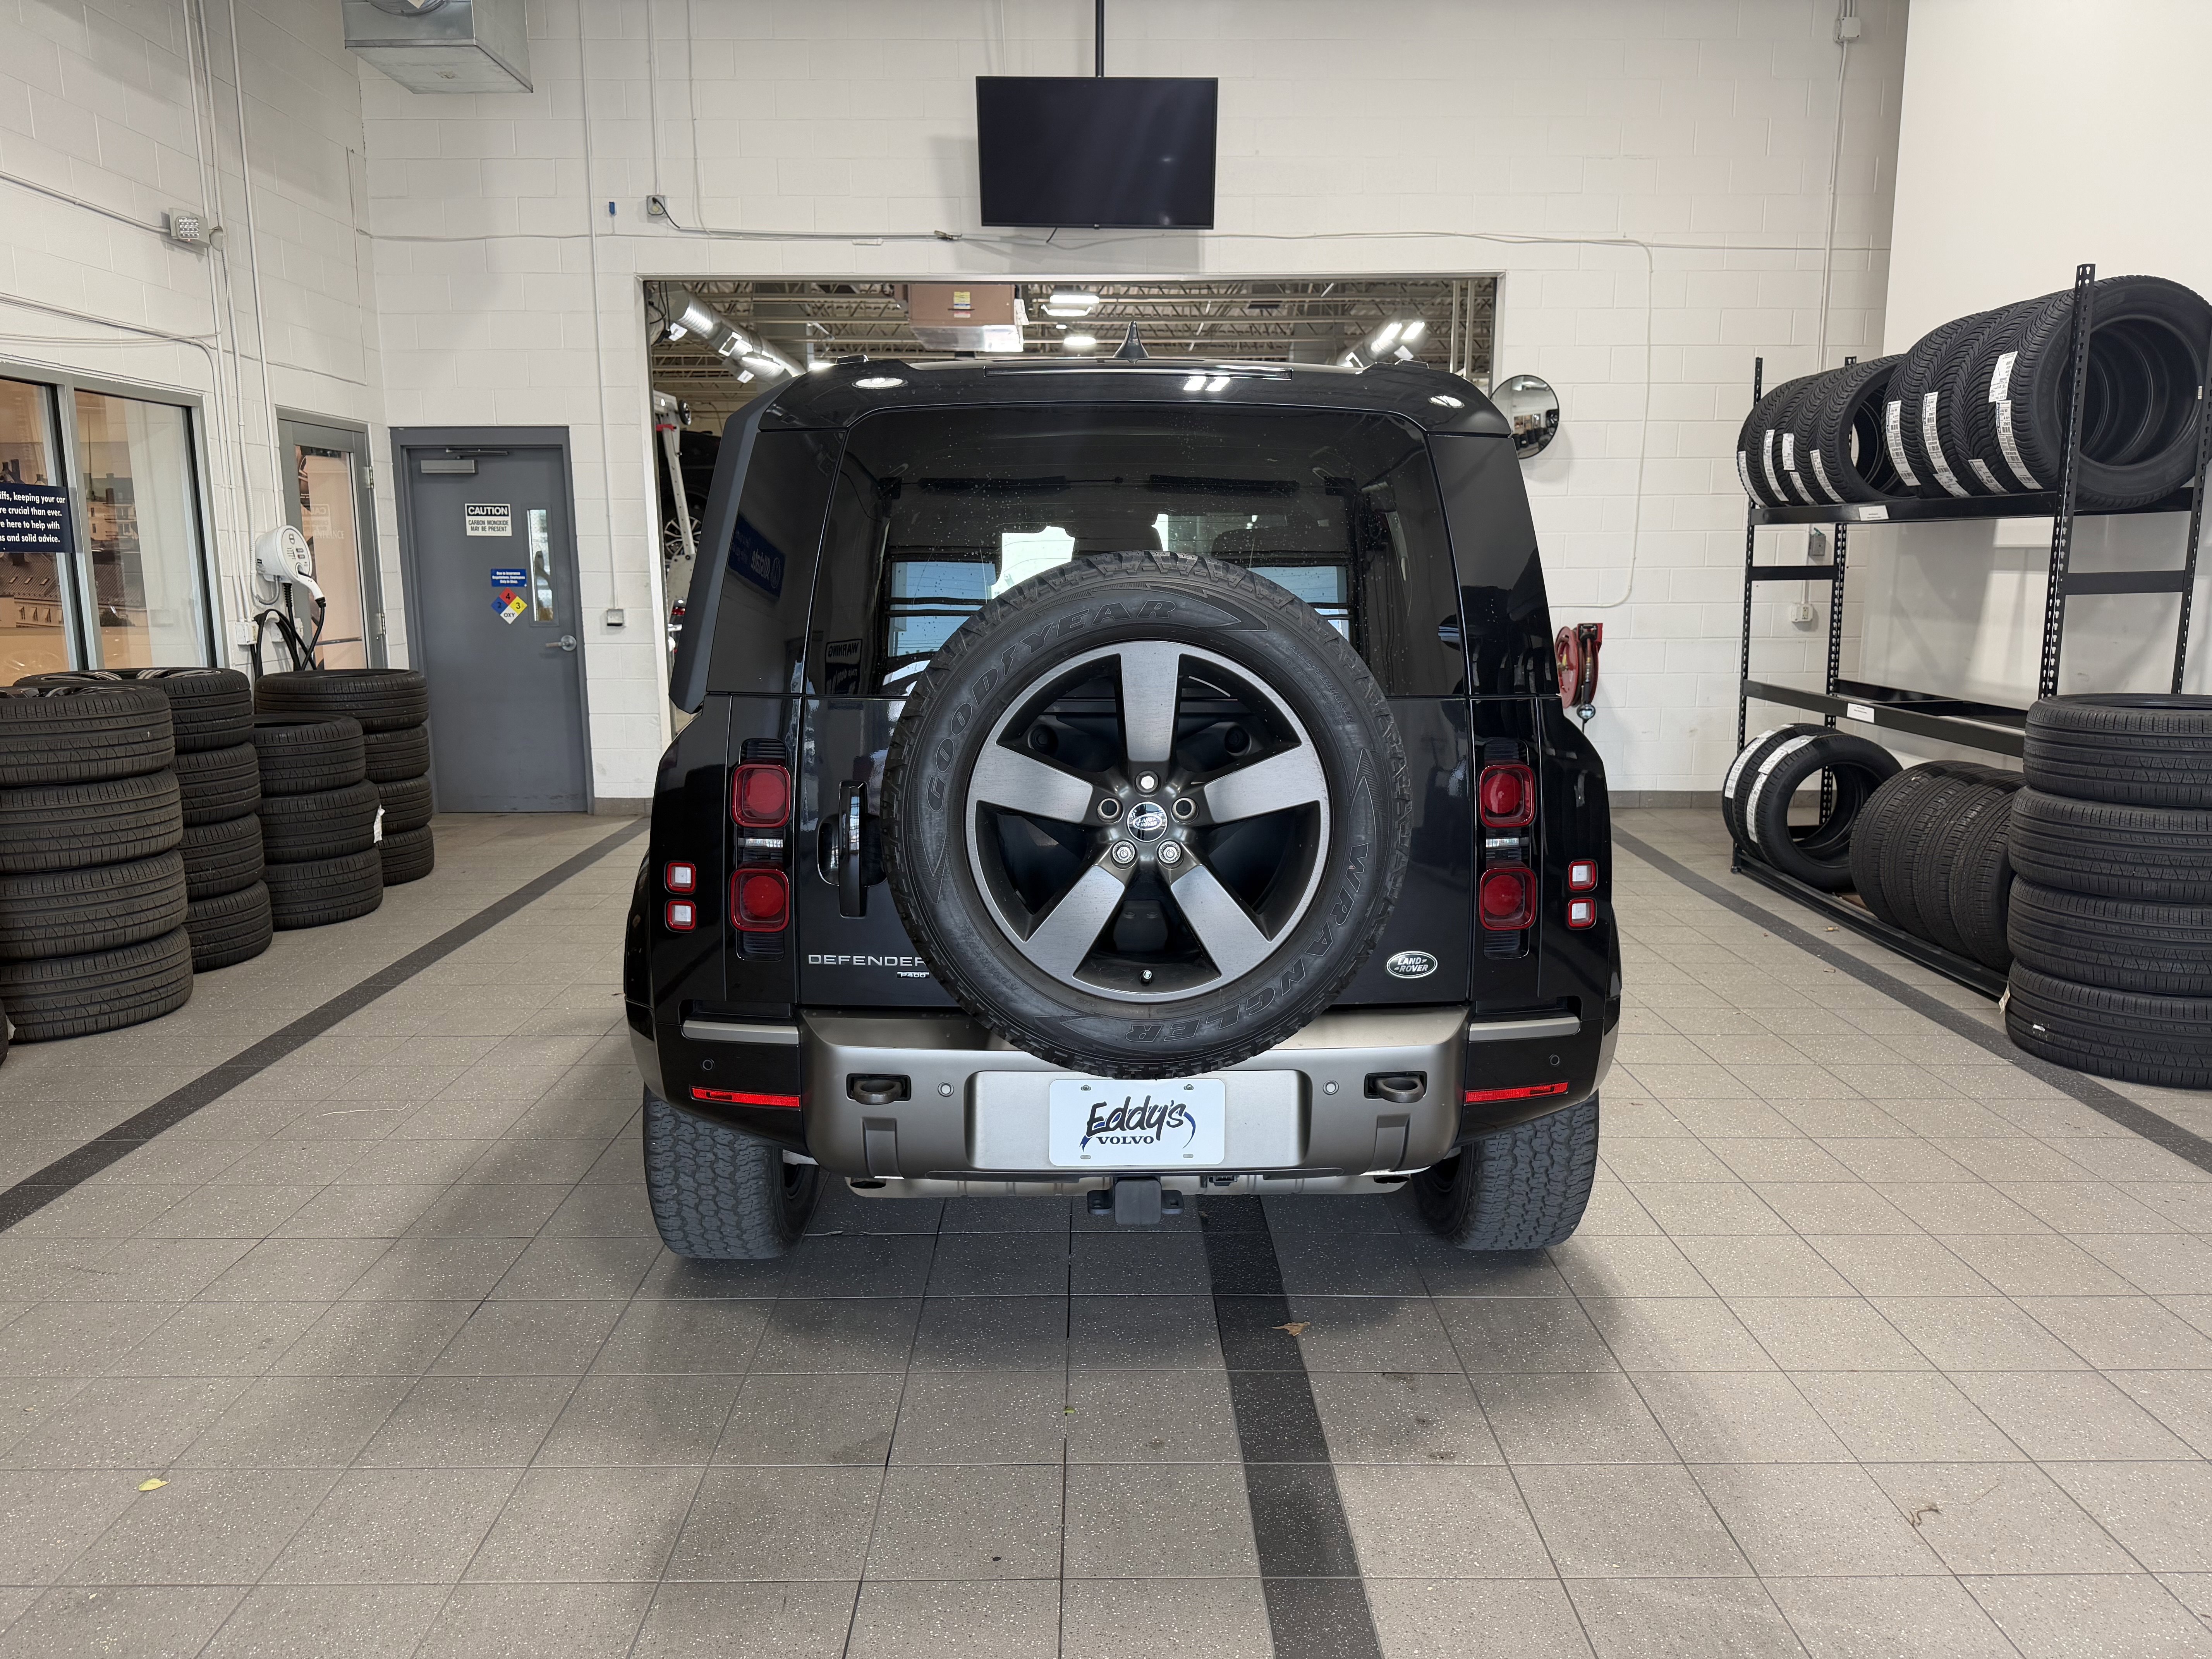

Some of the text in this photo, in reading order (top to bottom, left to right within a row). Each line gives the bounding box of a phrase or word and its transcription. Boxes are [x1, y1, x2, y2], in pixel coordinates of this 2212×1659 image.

[13, 491, 40, 503] keeping
[41, 496, 55, 504] your
[8, 506, 29, 515] crucial
[31, 507, 46, 515] than
[468, 507, 508, 515] CAUTION
[6, 519, 22, 528] here
[31, 520, 46, 531] help
[46, 521, 60, 530] with
[7, 533, 20, 542] and
[21, 533, 37, 542] solid
[38, 534, 60, 543] advice.
[926, 599, 1176, 812] GOODYEAR
[1125, 843, 1369, 1042] WRANGLER
[1397, 957, 1422, 965] LAND
[1085, 1095, 1187, 1141] Eddy's
[1096, 1136, 1154, 1144] VOLVO
